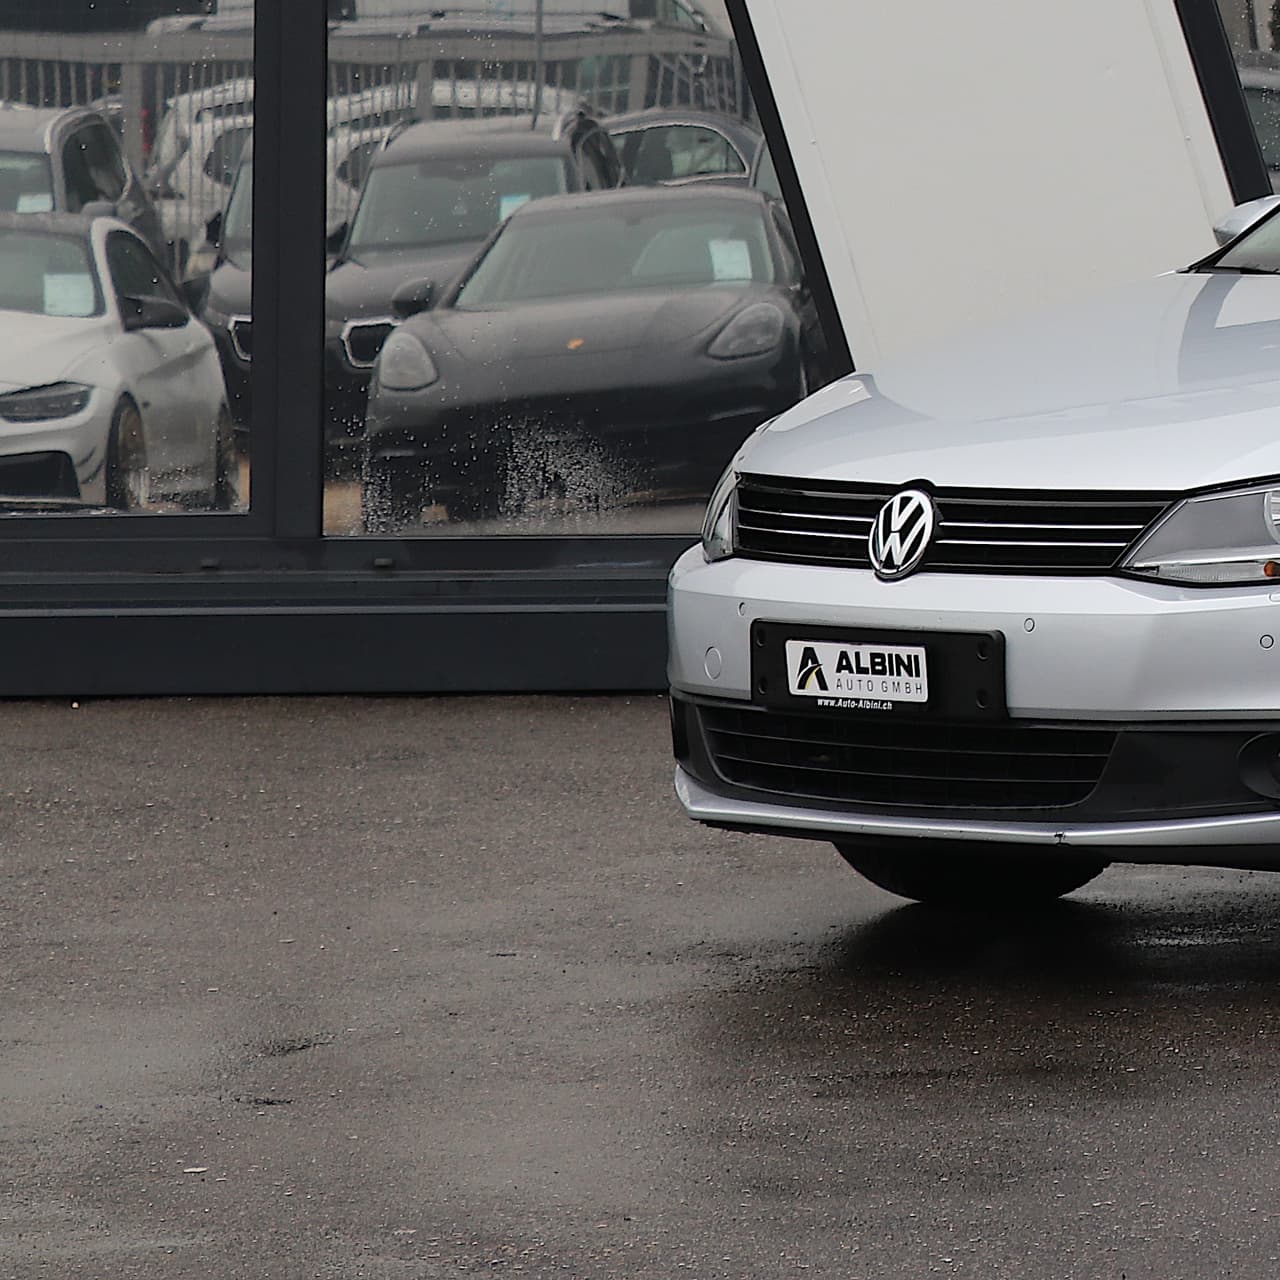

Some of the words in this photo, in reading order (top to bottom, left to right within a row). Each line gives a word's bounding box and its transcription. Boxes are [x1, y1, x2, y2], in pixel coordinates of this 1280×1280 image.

[835, 650, 921, 678] ALBINI
[836, 678, 874, 692] AUTO
[881, 681, 922, 695] GMBH
[817, 697, 893, 711] www.Auto-Albini.ch
